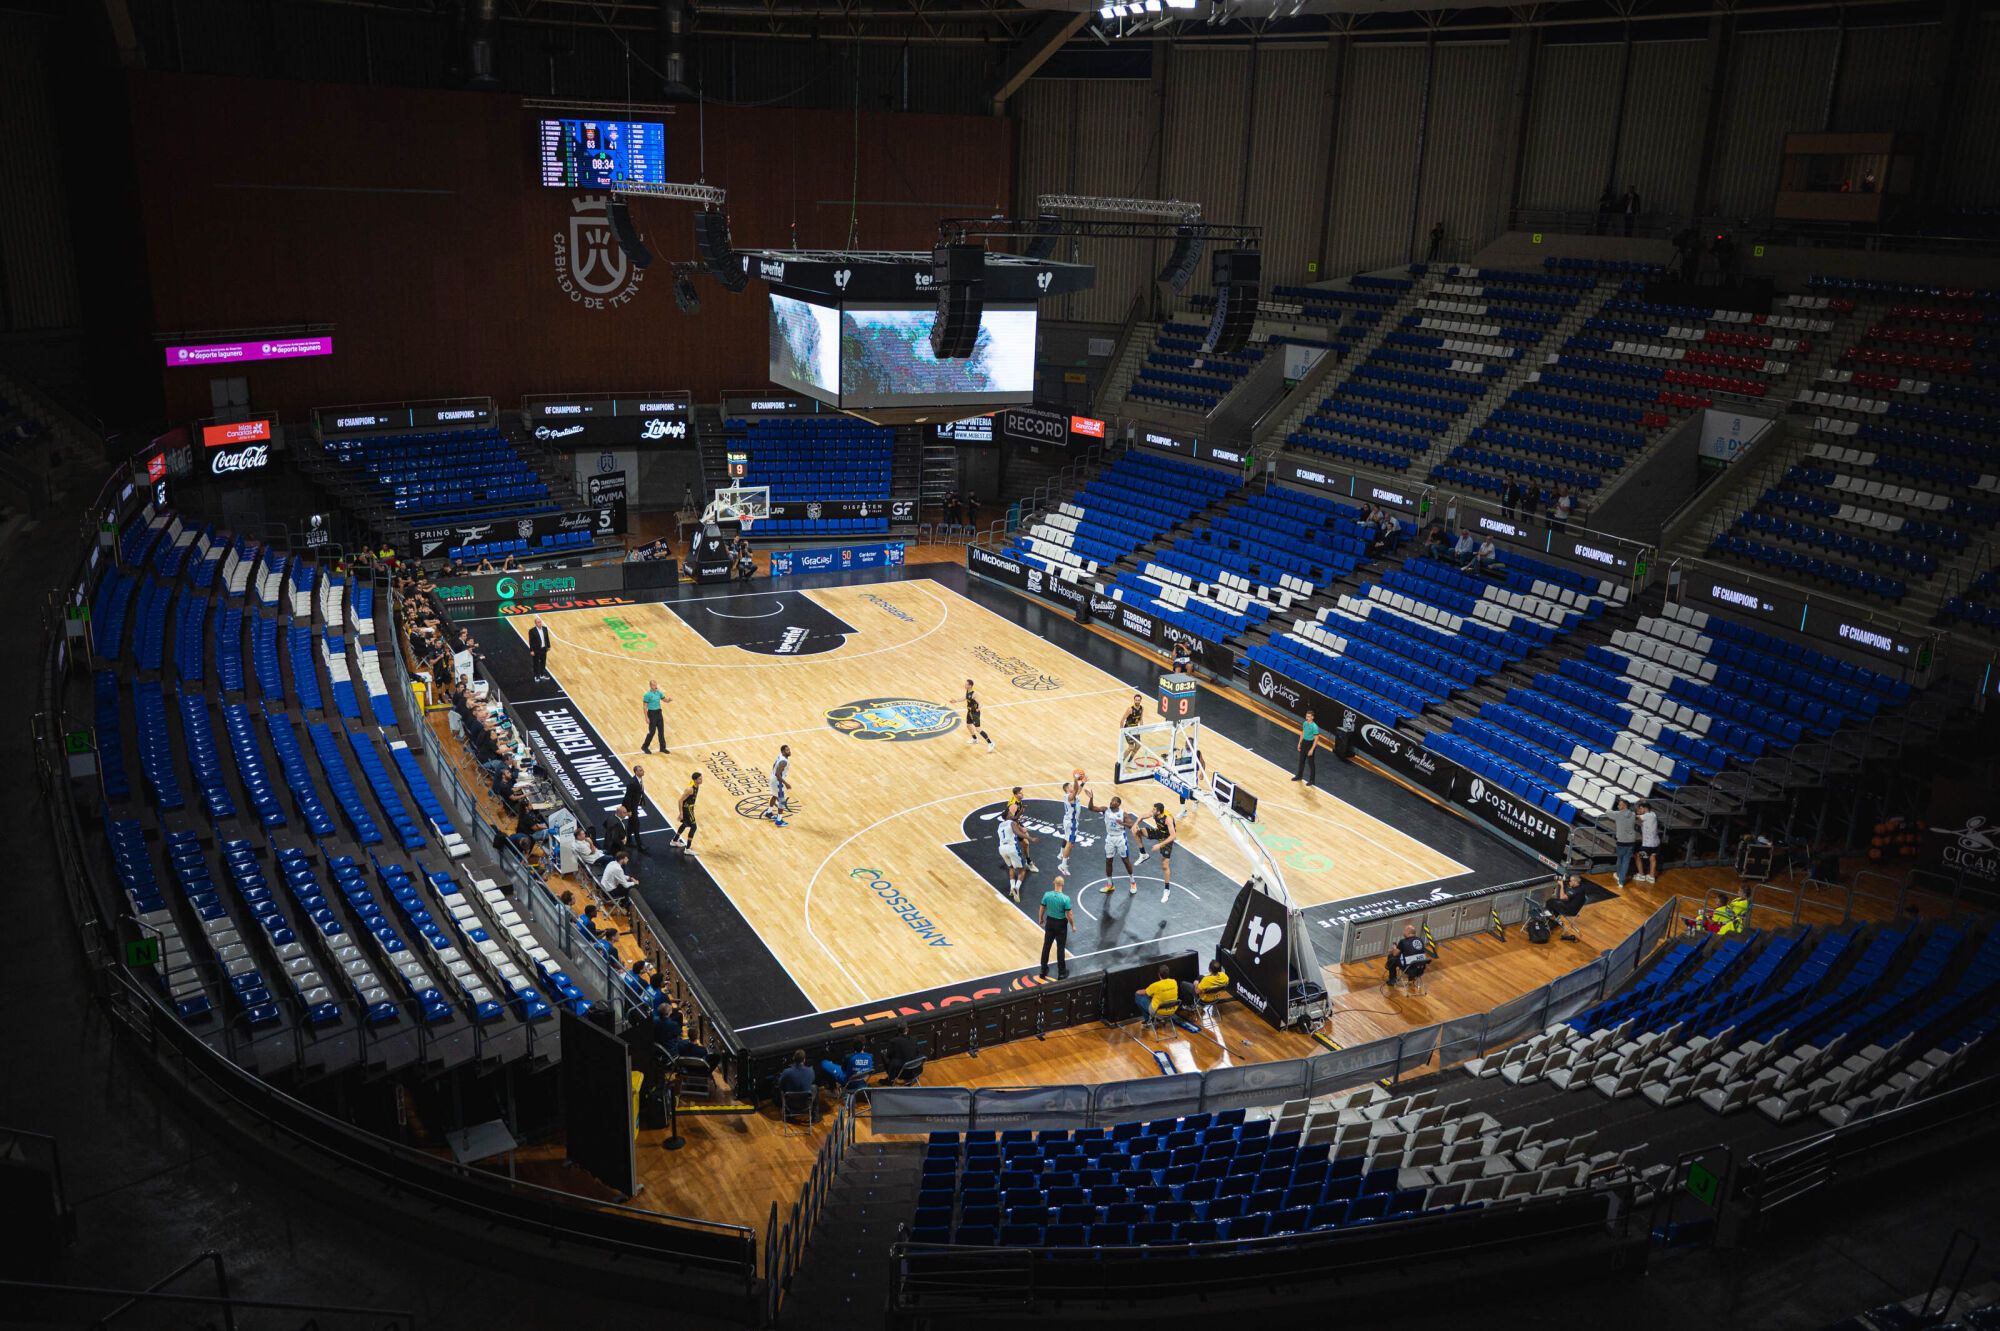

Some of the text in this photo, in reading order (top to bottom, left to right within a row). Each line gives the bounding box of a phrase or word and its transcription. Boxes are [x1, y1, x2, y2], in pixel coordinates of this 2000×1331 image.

[586, 139, 618, 150] 63 41
[592, 158, 615, 169] 08:34
[553, 232, 582, 302] CABILDO
[584, 296, 605, 310] DE
[195, 352, 217, 360] deporte
[218, 350, 243, 358] lagunero
[277, 345, 297, 353] deporte
[298, 344, 321, 352] lagunero
[545, 405, 581, 414] OF CHAMPIONS
[646, 403, 675, 411] CHAMPIONS
[751, 401, 785, 410] OF CHAMPIONS
[337, 416, 375, 427] OF CHAMPIONS
[438, 410, 475, 421] OF CHAMPIONS
[226, 429, 253, 438] Canarias
[641, 418, 686, 439] Libby's
[1008, 414, 1063, 438] RECORD
[1147, 433, 1172, 447] OF CHAMPIONS
[1212, 448, 1219, 458] OF
[1219, 450, 1239, 463] CHAMPIONS
[737, 465, 743, 475] 9
[1297, 468, 1325, 484] OF CHAMPIONS
[591, 491, 625, 504] HOVIMA
[1372, 488, 1403, 505] OF CHAMPIONS
[598, 510, 611, 528] 5
[1480, 517, 1515, 536] OF CHAMPIONS
[306, 530, 328, 538] COSTA
[306, 535, 328, 545] ADEJE
[414, 529, 450, 540] SPRING
[1575, 544, 1614, 565] OF CHAMPIONS
[980, 554, 1021, 575] McDonald's
[433, 584, 475, 599] reen
[521, 575, 576, 597] green
[1057, 585, 1085, 603] Hospiten
[533, 597, 636, 611] SUNEL
[1712, 585, 1758, 609] OF CHAMPIONS
[1123, 609, 1152, 628] TERRENOS
[1839, 623, 1892, 651] OF CHAMPIONS
[1175, 681, 1195, 691] 08:34
[1162, 696, 1188, 715] 9 9
[535, 706, 596, 756] TENERIFE
[1369, 727, 1401, 754] Balmes
[570, 753, 627, 801] LAGUNA
[701, 756, 745, 797] BASKETBALL
[711, 750, 762, 794] CHAMPIONS
[1497, 811, 1535, 837] TENERIFE SUR
[1943, 846, 1998, 871] CICAR
[870, 879, 954, 947] AMERESCO
[1360, 899, 1399, 911] TENERIFE
[136, 944, 151, 963] N
[1696, 1177, 1708, 1193] J
